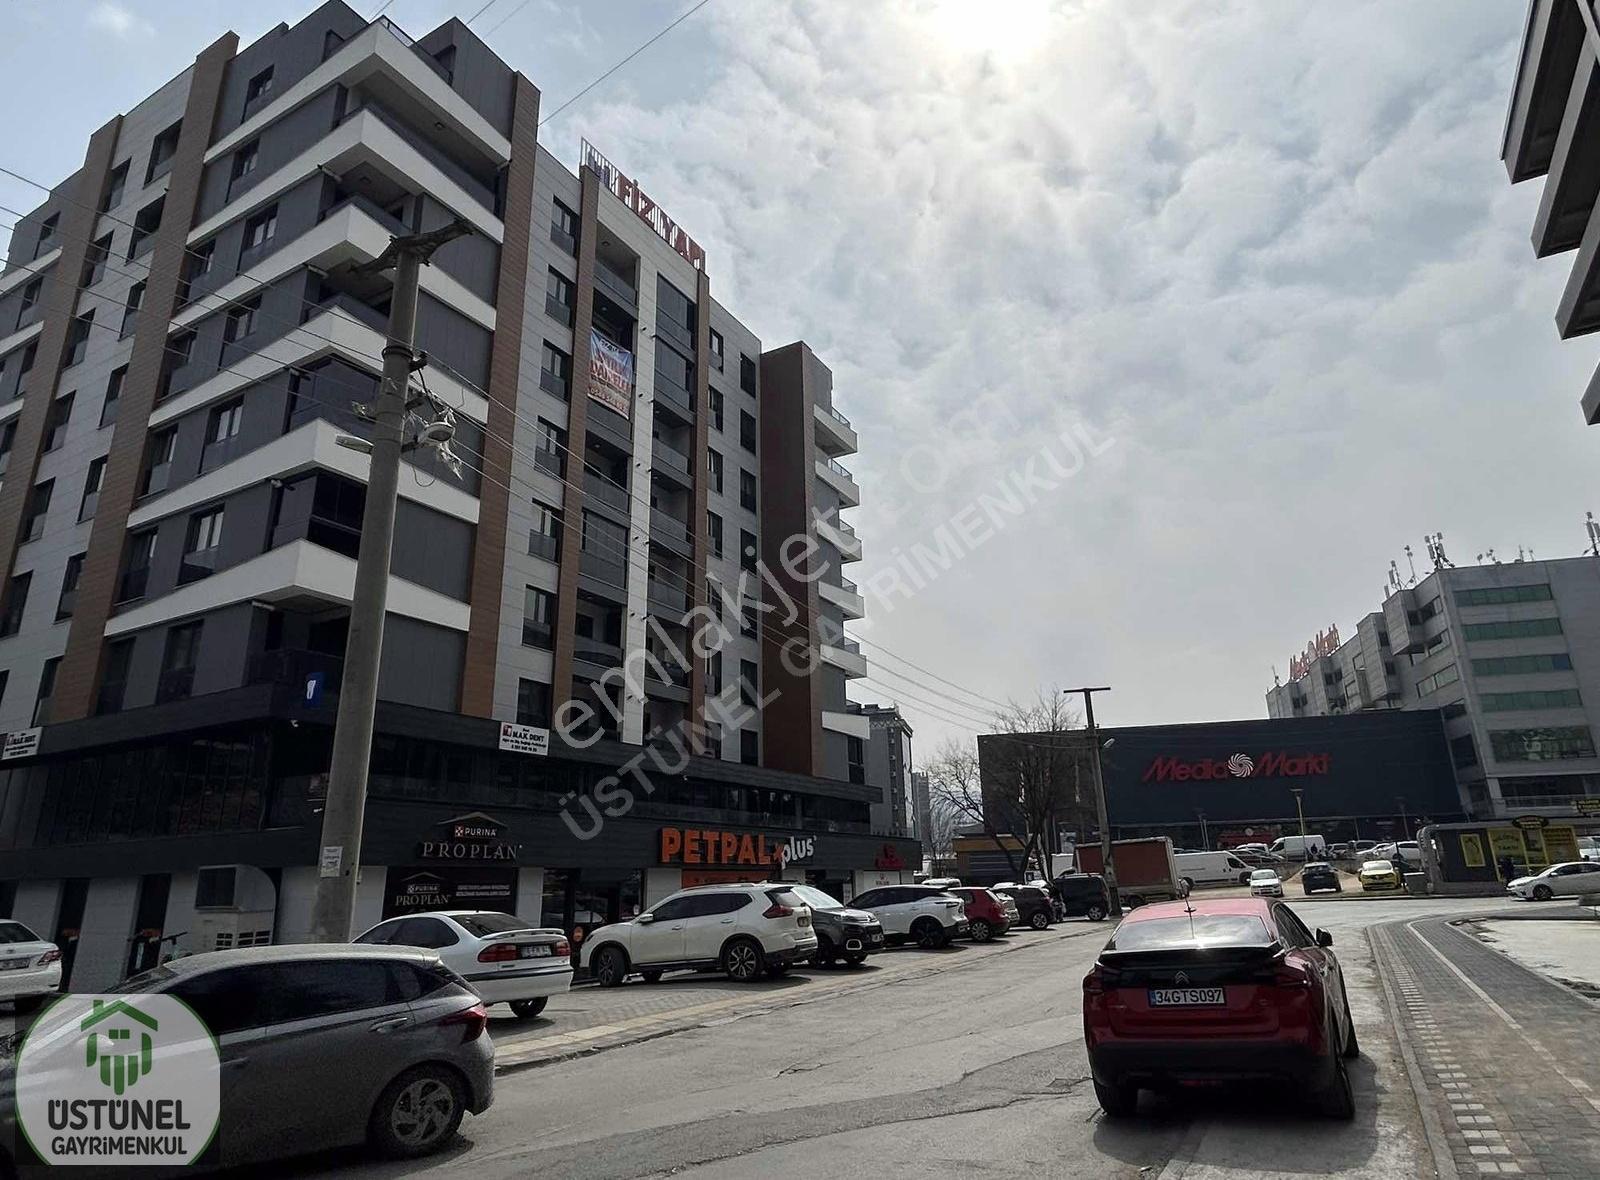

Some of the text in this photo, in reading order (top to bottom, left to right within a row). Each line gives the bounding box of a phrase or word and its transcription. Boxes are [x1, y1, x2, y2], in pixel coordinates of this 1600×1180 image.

[1141, 751, 1332, 783] Media Markt
[464, 827, 497, 837] PURINA
[660, 827, 815, 871] PETPAL plus
[1155, 988, 1223, 1004] 34GTS097
